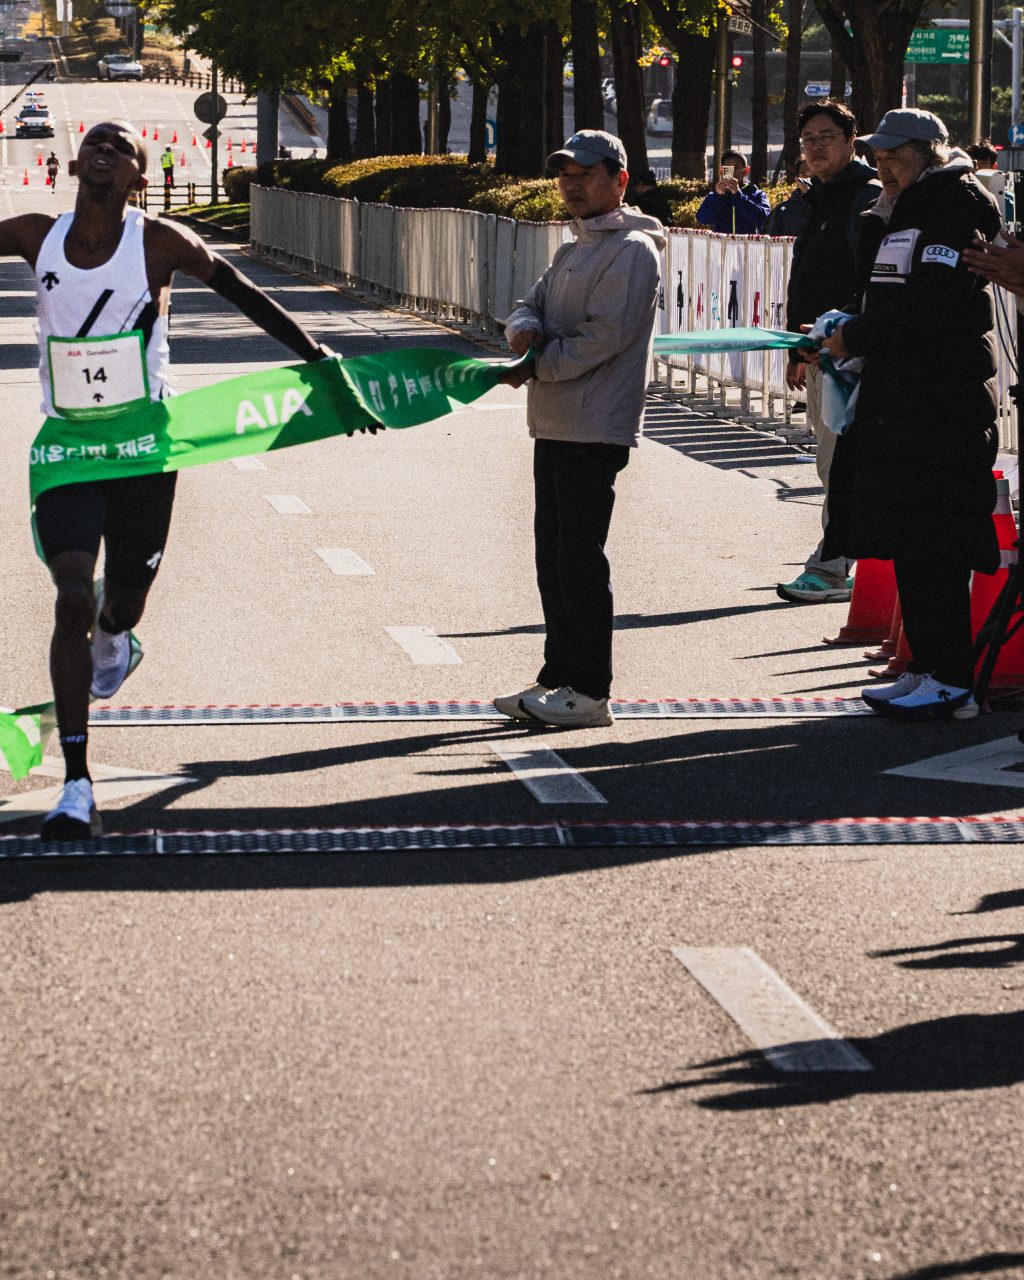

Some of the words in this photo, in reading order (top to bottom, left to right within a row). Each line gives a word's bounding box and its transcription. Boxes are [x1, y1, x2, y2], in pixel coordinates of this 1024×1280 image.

[82, 367, 108, 384] 14
[235, 387, 313, 435] AIA
[114, 433, 160, 459] 제로
